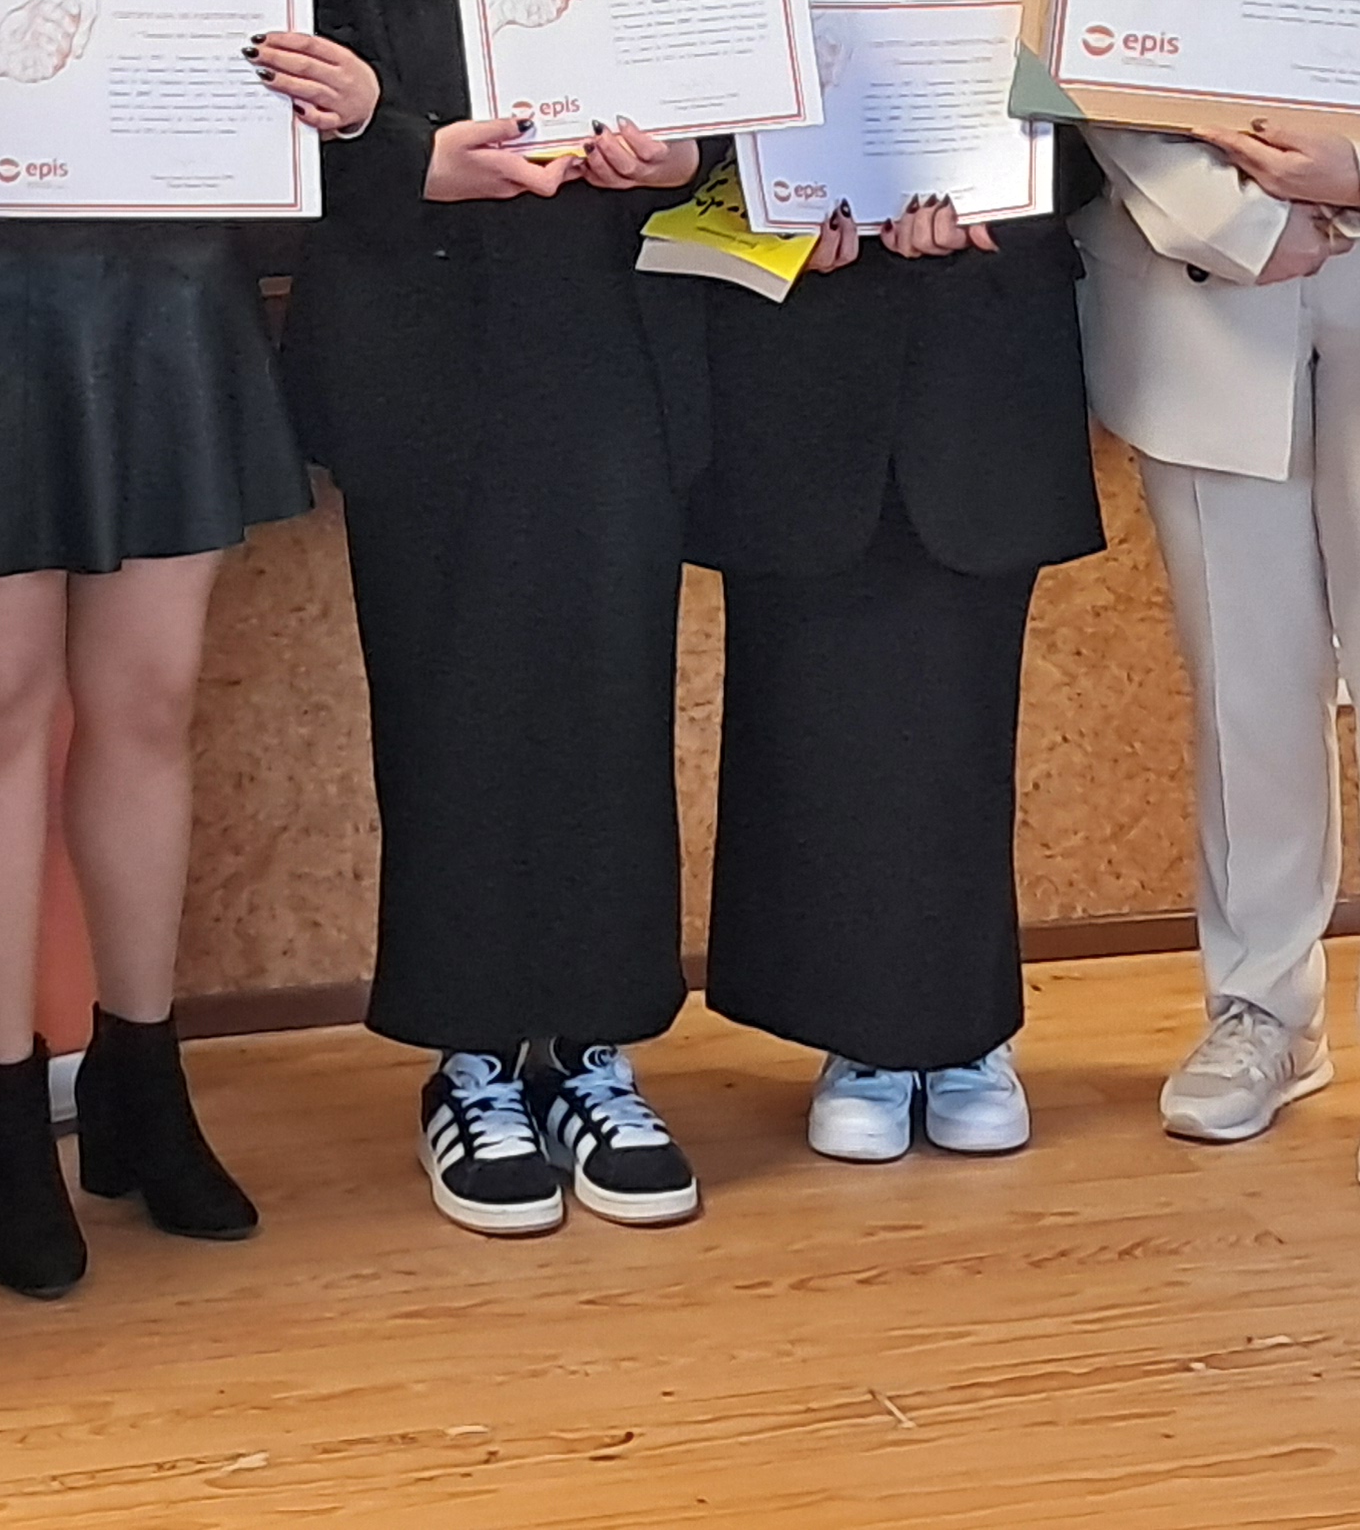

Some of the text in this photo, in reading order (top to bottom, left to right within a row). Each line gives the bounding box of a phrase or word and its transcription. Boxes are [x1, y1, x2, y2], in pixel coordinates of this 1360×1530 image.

[1122, 31, 1180, 57] epis
[539, 95, 581, 118] epis
[25, 158, 69, 181] epis
[794, 181, 828, 201] epis
